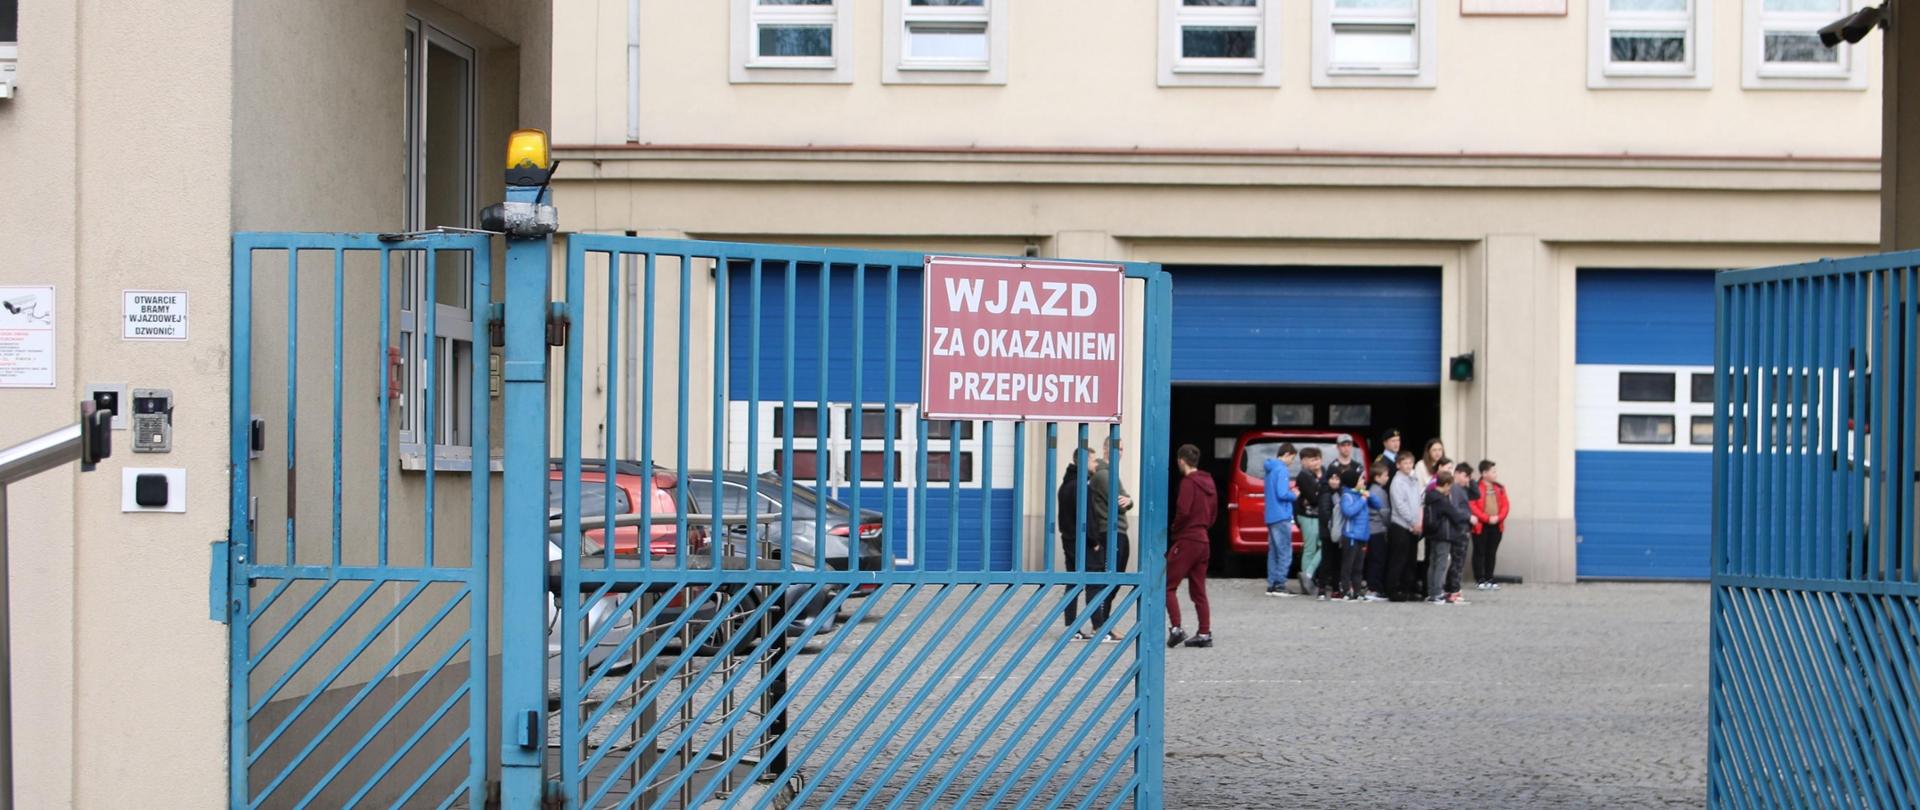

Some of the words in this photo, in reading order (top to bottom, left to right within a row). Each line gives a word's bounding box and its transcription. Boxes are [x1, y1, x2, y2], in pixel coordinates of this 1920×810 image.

[134, 295, 177, 304] OTWARCIE
[944, 277, 1098, 317] WJAZD
[141, 305, 170, 313] BRAMY
[129, 314, 182, 322] WJAZDOWEJ
[135, 325, 175, 336] DZWONIĆ!
[933, 327, 966, 356] ZA
[973, 328, 1115, 361] OKAZANIEM
[948, 371, 1099, 404] PRZEPUSTKI
